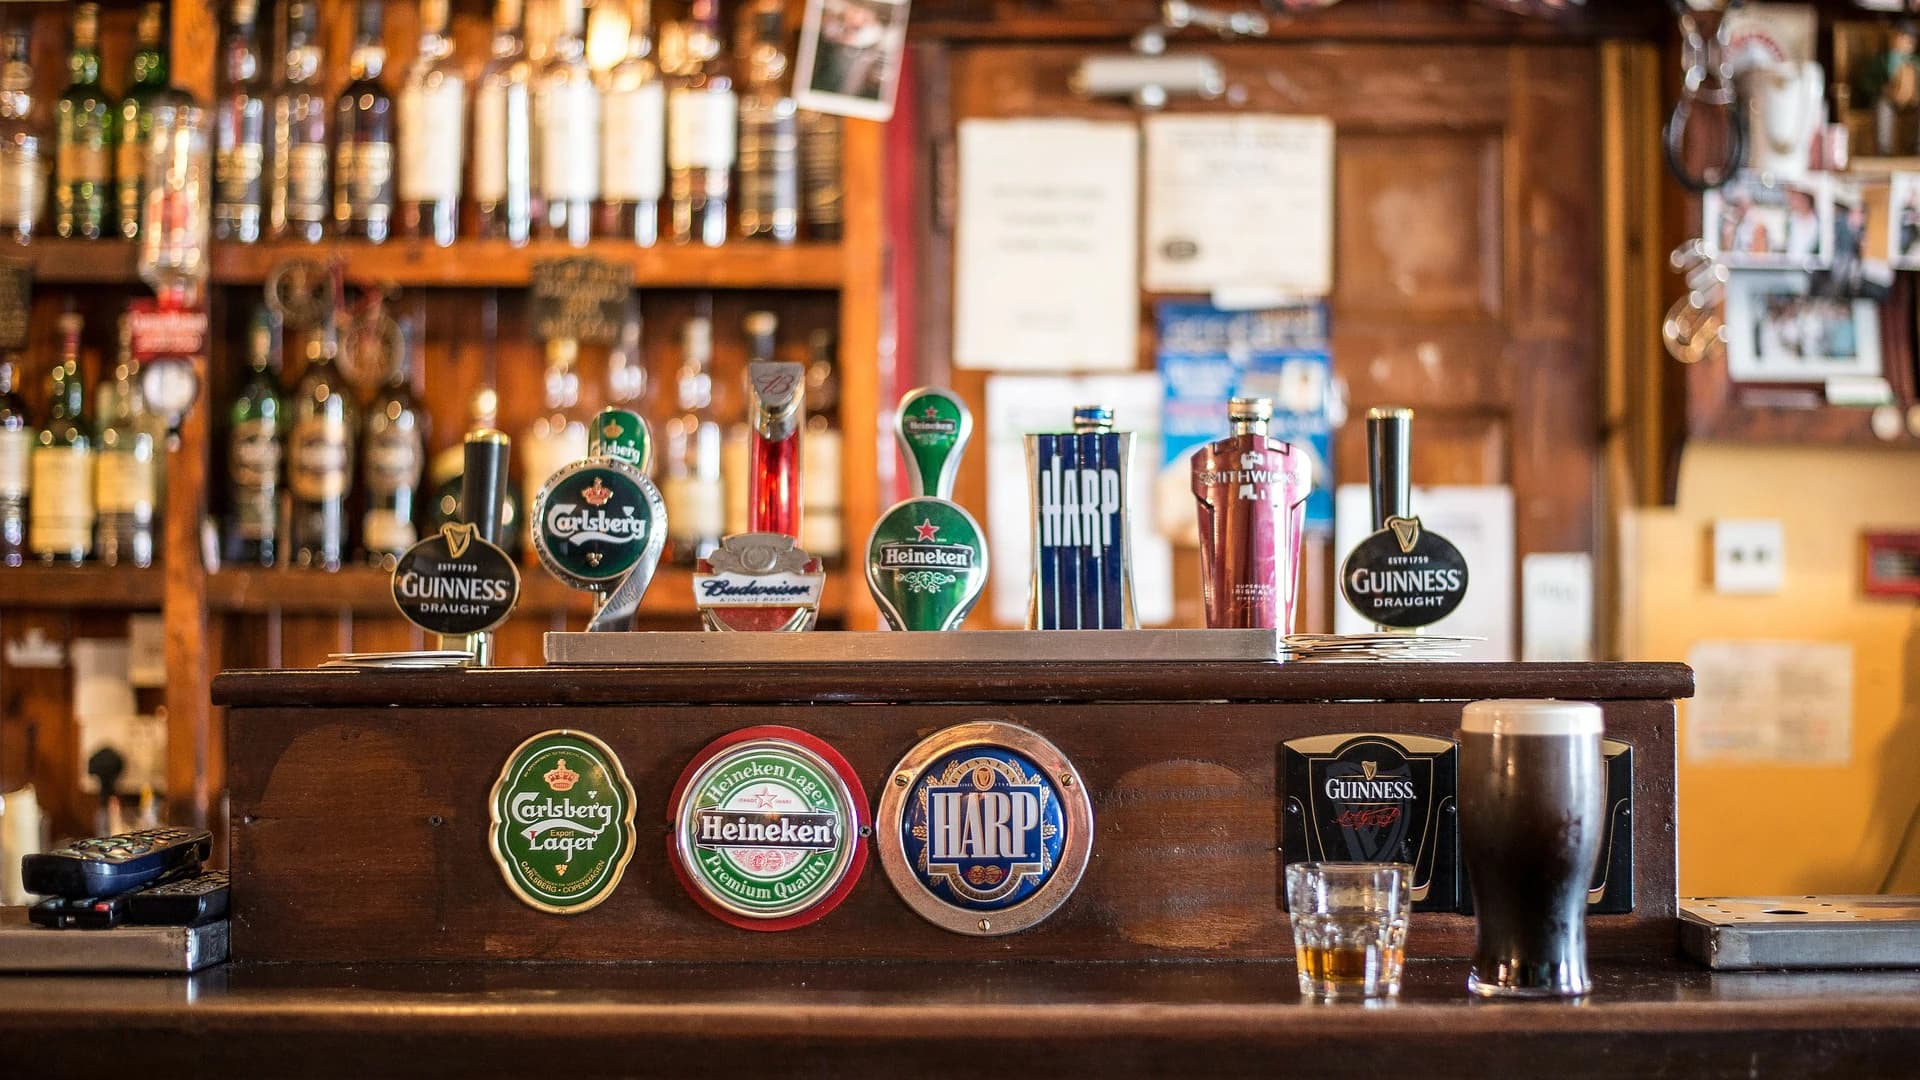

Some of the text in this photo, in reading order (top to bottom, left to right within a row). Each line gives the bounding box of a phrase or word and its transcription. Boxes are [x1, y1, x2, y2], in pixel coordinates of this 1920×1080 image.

[910, 421, 953, 430] Heineken
[1042, 455, 1119, 558] HARP
[547, 504, 646, 542] Carlsberg
[886, 549, 968, 566] Heineken
[401, 571, 508, 601] GUINNESS
[701, 580, 811, 596] Budweiser
[1351, 568, 1460, 594] GUINNESS
[420, 603, 489, 615] DRAUGHT
[1374, 596, 1444, 608] DRAUGHT
[706, 762, 828, 807] Heineken Lager
[1325, 778, 1414, 800] GUINNESS
[512, 792, 613, 826] Carlsberg
[550, 829, 575, 838] Export
[702, 815, 832, 843] Heineken
[932, 791, 1039, 859] HARP
[529, 831, 599, 863] Lager
[521, 860, 557, 893] CARLSBERG
[562, 859, 606, 893] COPENHAGEN
[706, 855, 828, 899] Premium Quality
